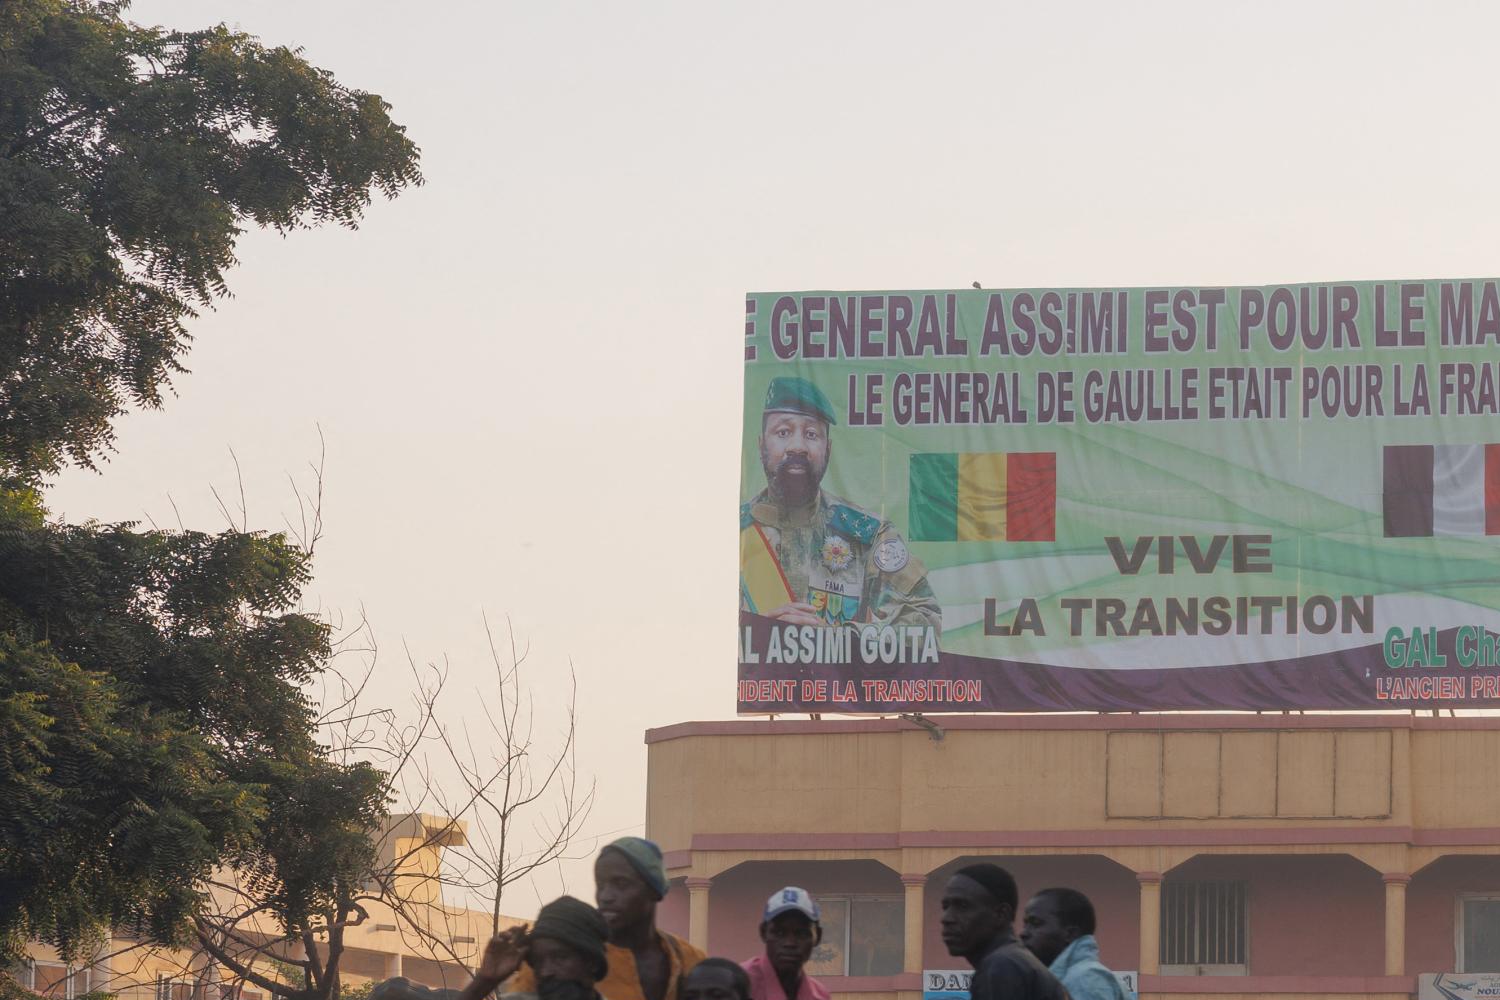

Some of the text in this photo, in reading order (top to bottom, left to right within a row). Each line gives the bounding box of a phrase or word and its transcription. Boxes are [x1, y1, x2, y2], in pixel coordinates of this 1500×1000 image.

[770, 293, 968, 360] GENERAL
[979, 290, 1128, 356] ASSIMI
[1144, 287, 1227, 353] EST
[1239, 283, 1360, 351] POUR
[1374, 283, 1427, 348] LE
[848, 373, 884, 426] LE
[893, 371, 1028, 425] GENERAL
[1037, 370, 1074, 423] DE
[1083, 367, 1199, 422] GAULLE
[1208, 365, 1293, 420] ETAIT
[1302, 364, 1384, 419] POUR
[1393, 363, 1431, 417] LA
[1103, 534, 1273, 576] VIVE
[825, 580, 845, 593] FAMA
[984, 594, 1375, 637] LA TRANSITION
[765, 625, 851, 665] ASSIMI
[859, 624, 940, 664] GOITA
[1383, 626, 1448, 669] GAL
[801, 680, 827, 702] DE
[831, 680, 858, 702] LA
[864, 679, 982, 702] TRANSITION
[1376, 675, 1466, 700] L'ANCIEN
